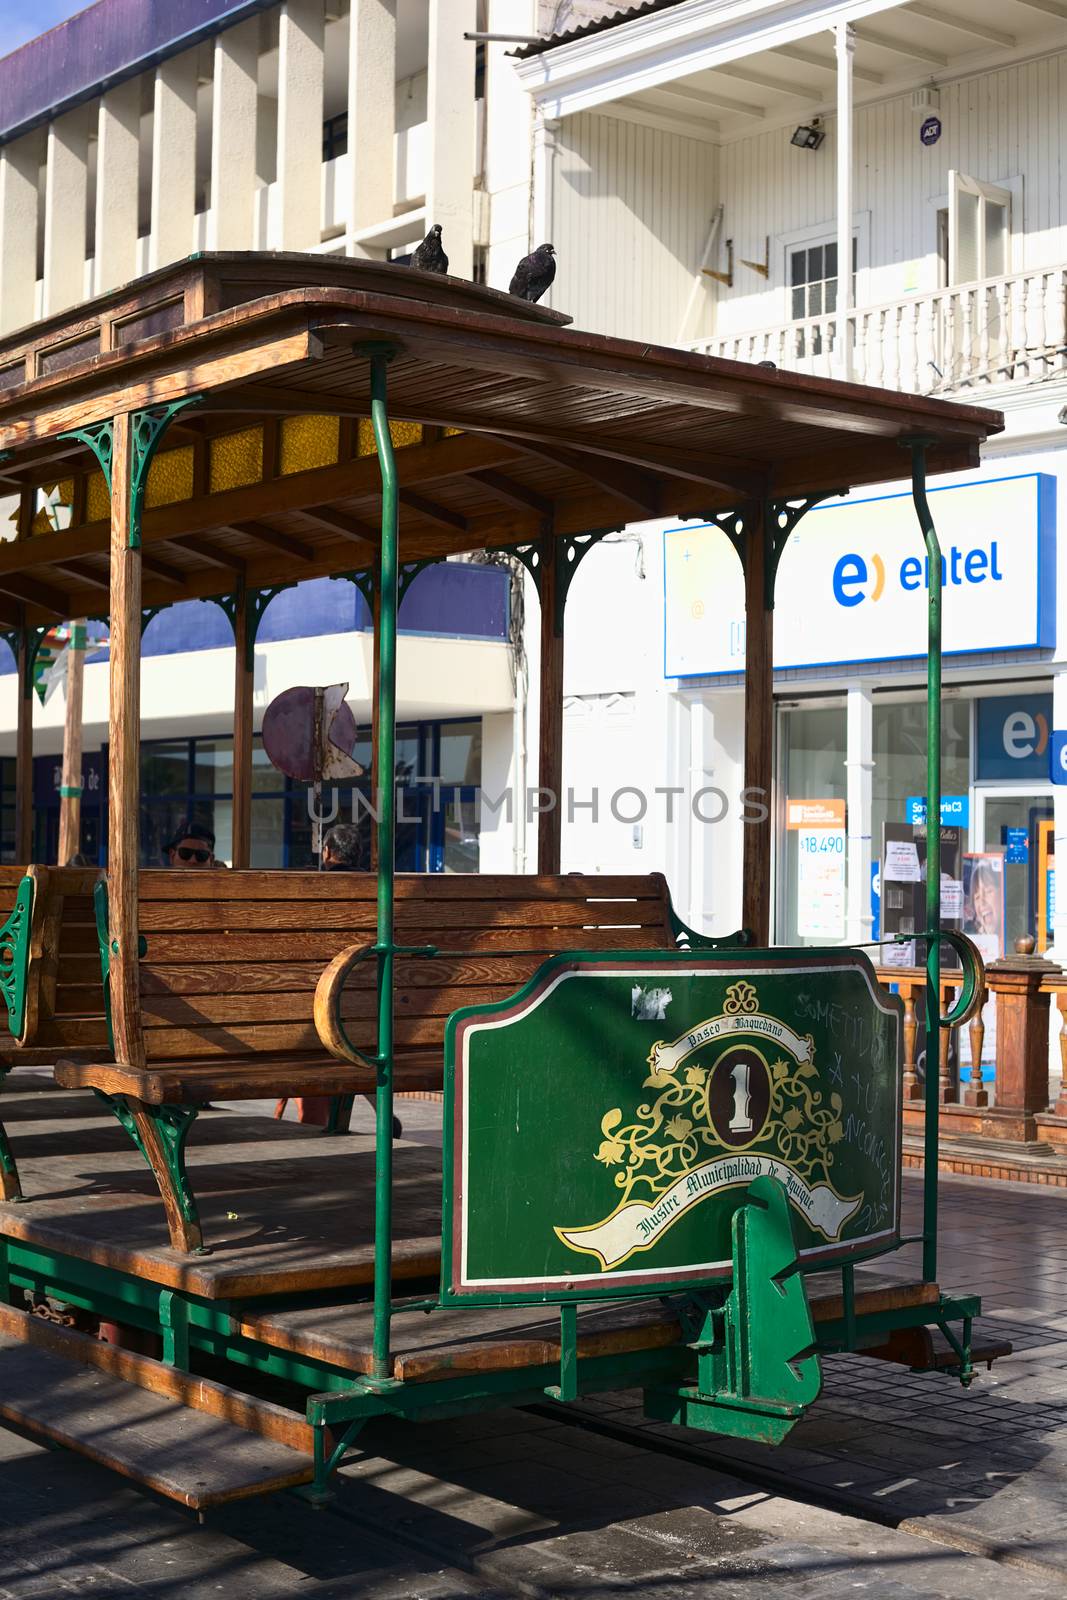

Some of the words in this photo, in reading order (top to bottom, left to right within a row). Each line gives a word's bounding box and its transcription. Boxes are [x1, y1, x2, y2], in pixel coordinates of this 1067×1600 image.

[687, 1023, 721, 1047] Paseo
[728, 1064, 753, 1133] 1
[687, 1157, 762, 1198] Municipalidad
[767, 1160, 779, 1178] de
